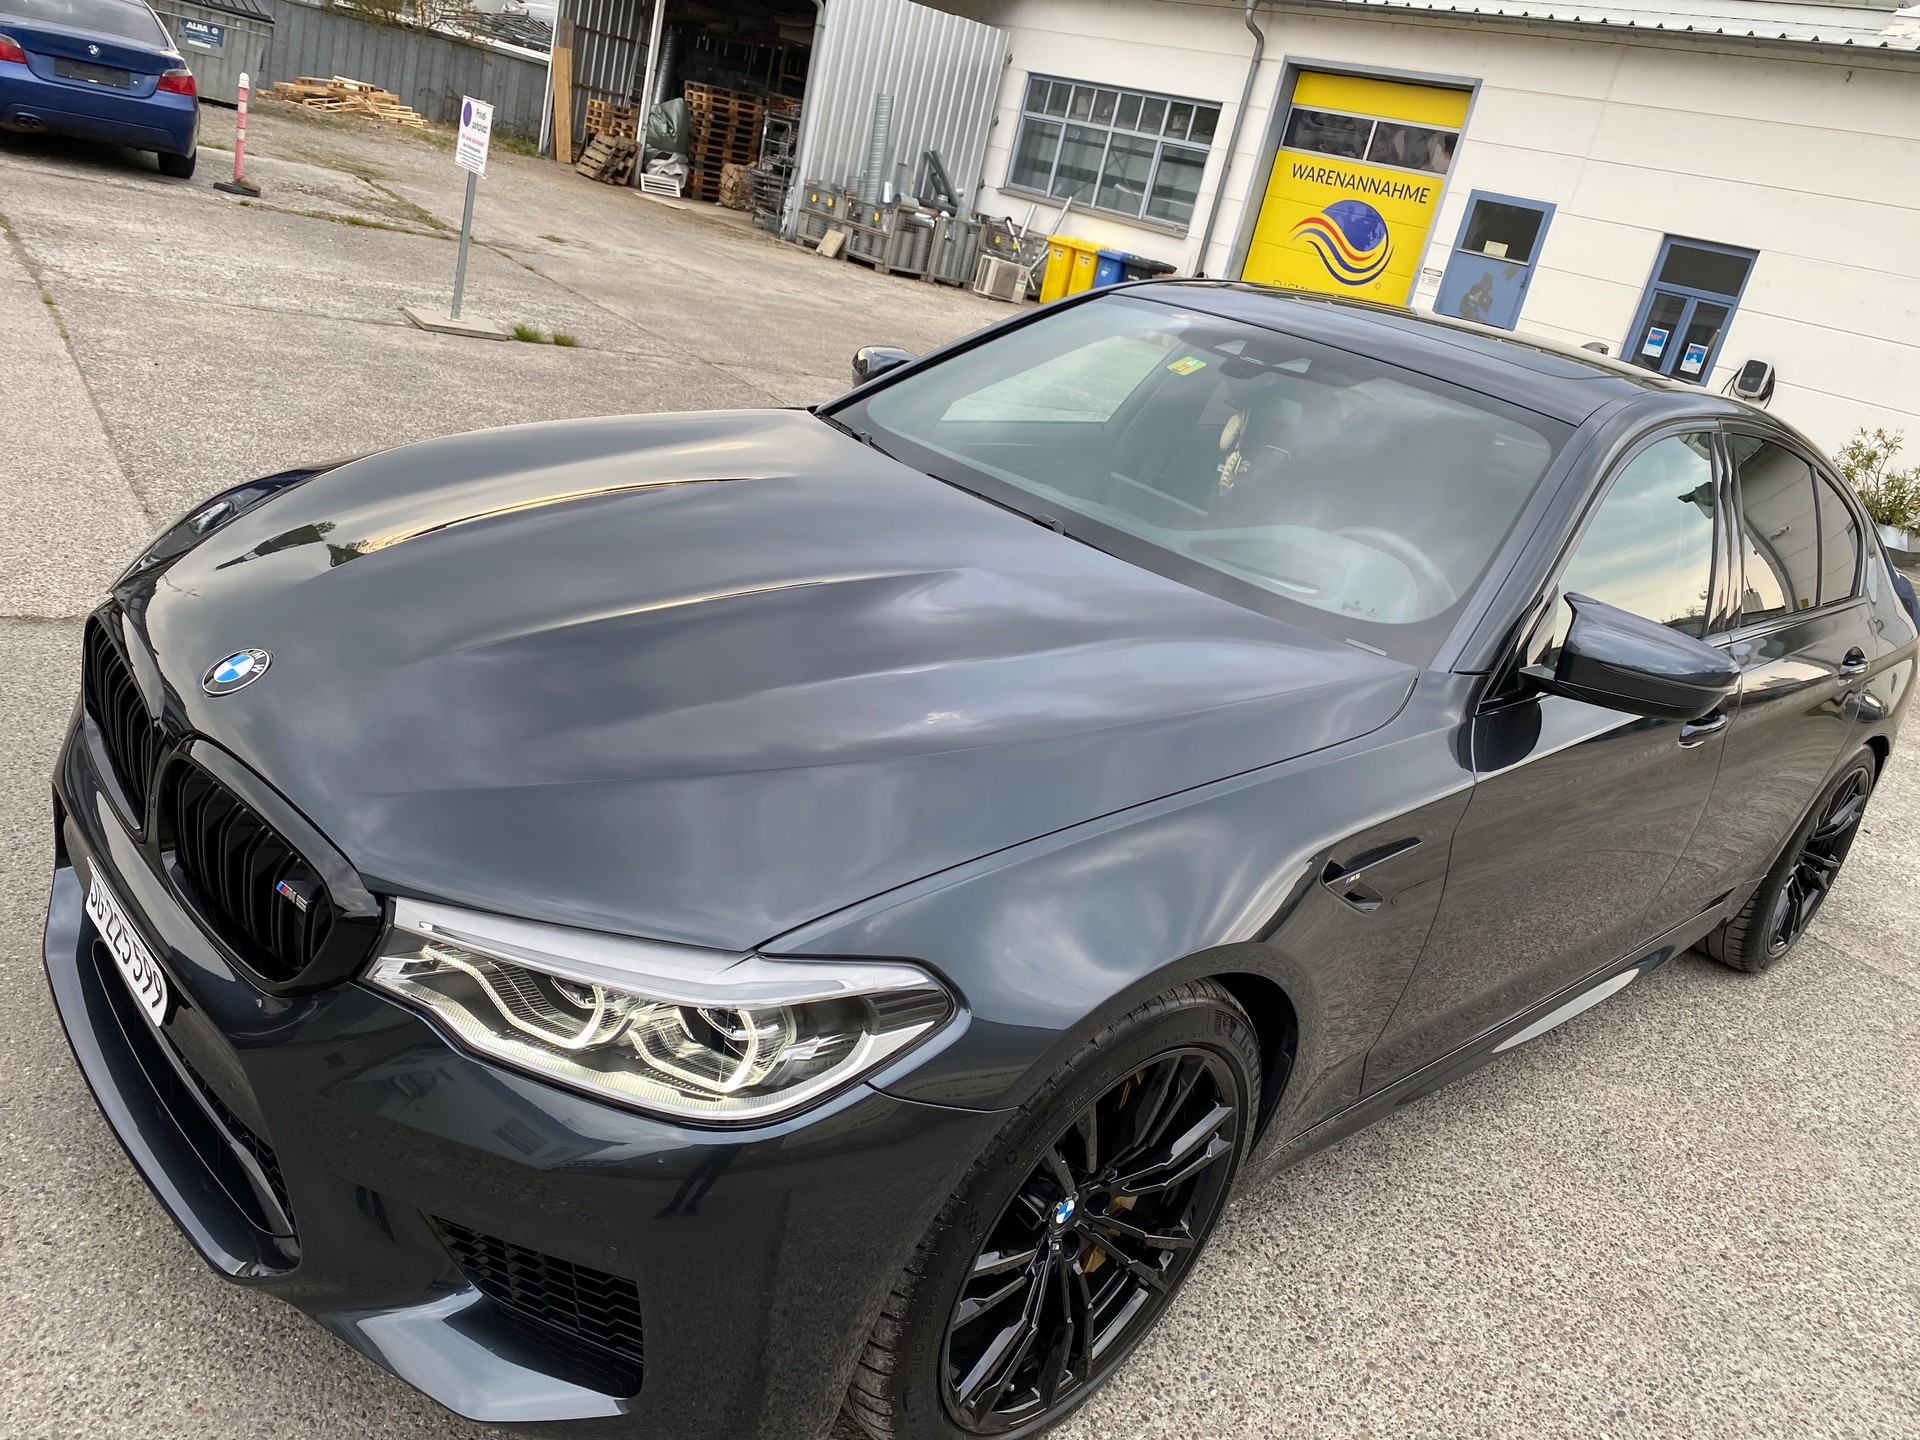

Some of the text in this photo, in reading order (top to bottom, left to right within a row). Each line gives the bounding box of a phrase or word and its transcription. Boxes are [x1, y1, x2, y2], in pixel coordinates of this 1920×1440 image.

[186, 21, 208, 33] ALBA
[1292, 163, 1431, 204] WARENANNAHME
[282, 886, 308, 913] M5
